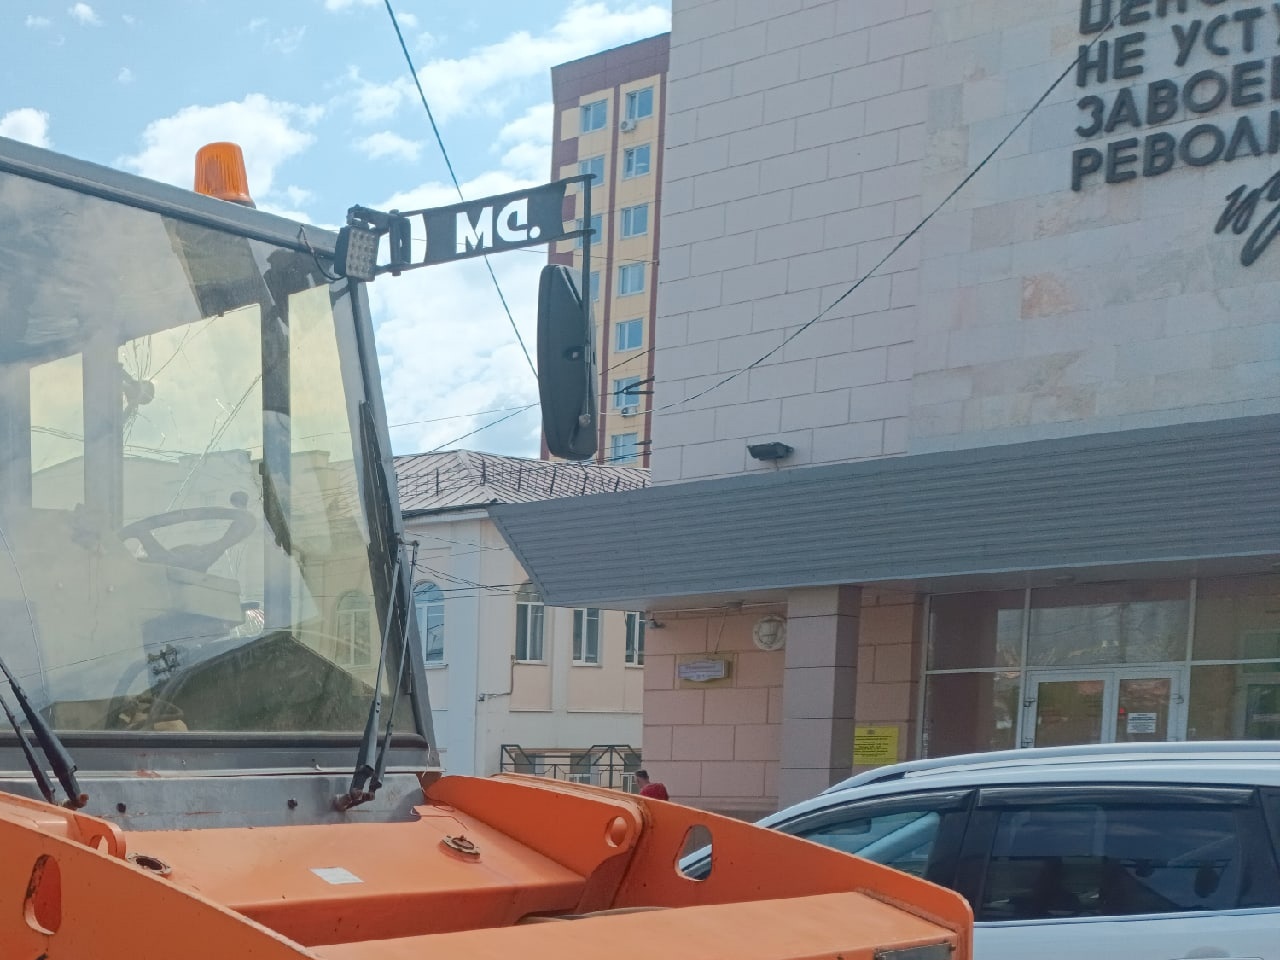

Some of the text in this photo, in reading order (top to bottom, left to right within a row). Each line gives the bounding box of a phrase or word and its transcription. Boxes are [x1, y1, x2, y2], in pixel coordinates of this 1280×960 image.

[1076, 1, 1280, 88] НЕ УСТ
[1071, 110, 1280, 192] РЕВОЛ
